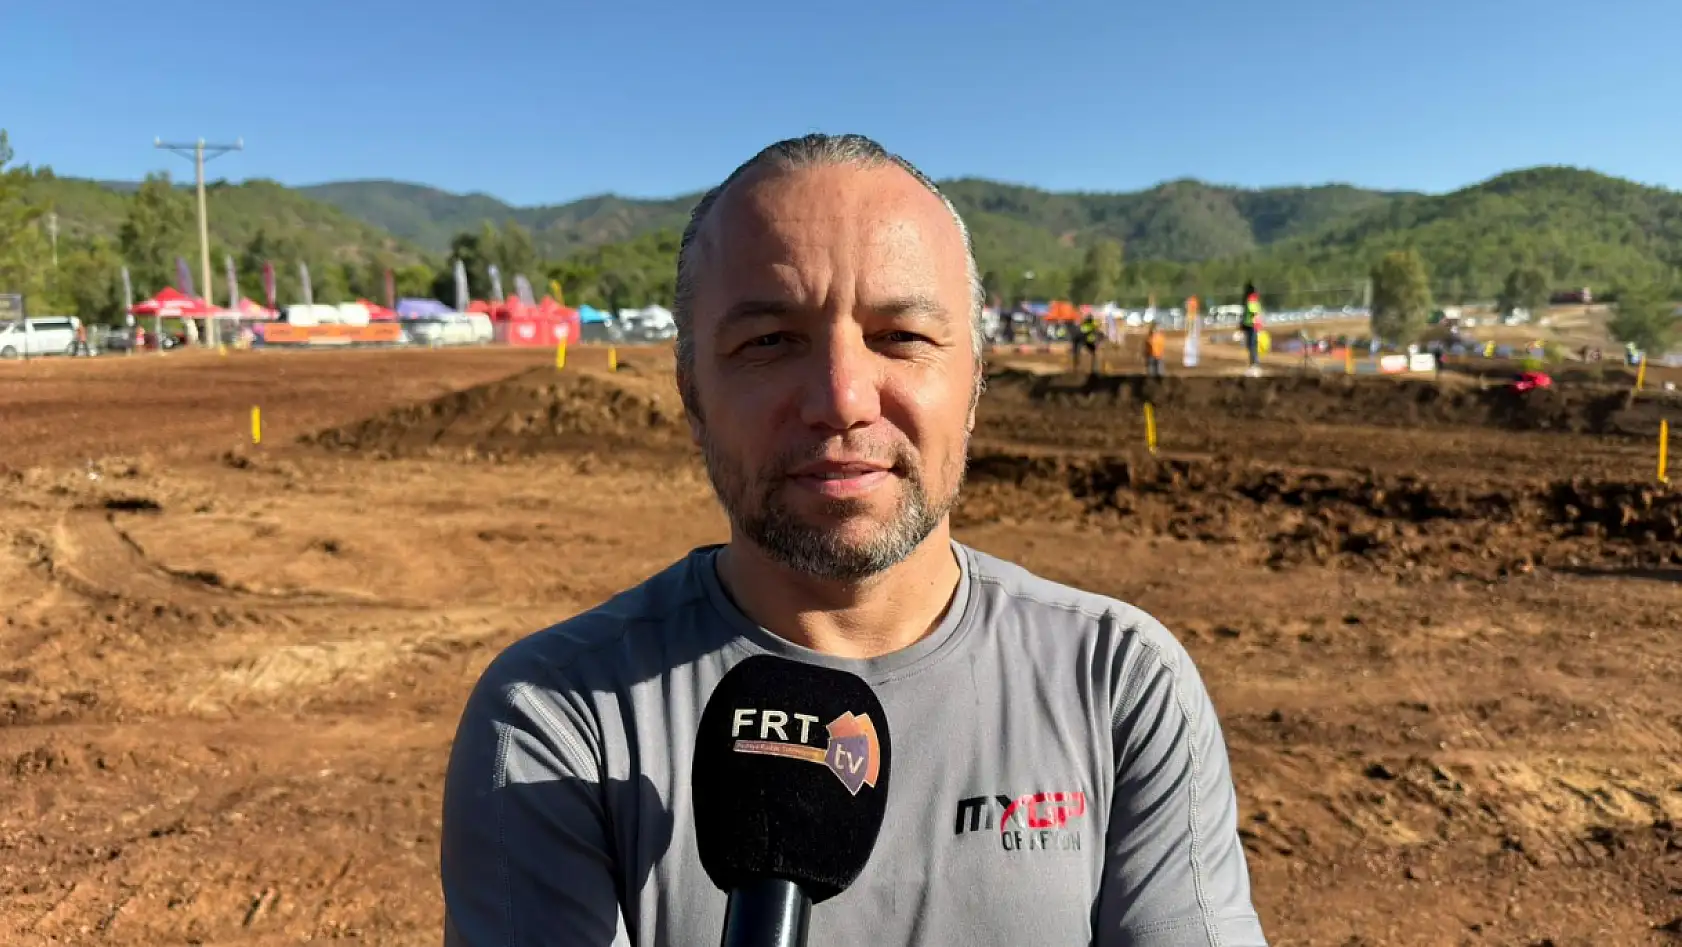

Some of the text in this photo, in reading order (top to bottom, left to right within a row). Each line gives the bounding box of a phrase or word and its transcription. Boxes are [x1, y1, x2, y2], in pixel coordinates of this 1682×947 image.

[731, 708, 819, 744] FRT
[834, 743, 865, 774] tv
[955, 791, 1087, 835] MXGP
[1002, 830, 1023, 851] OF
